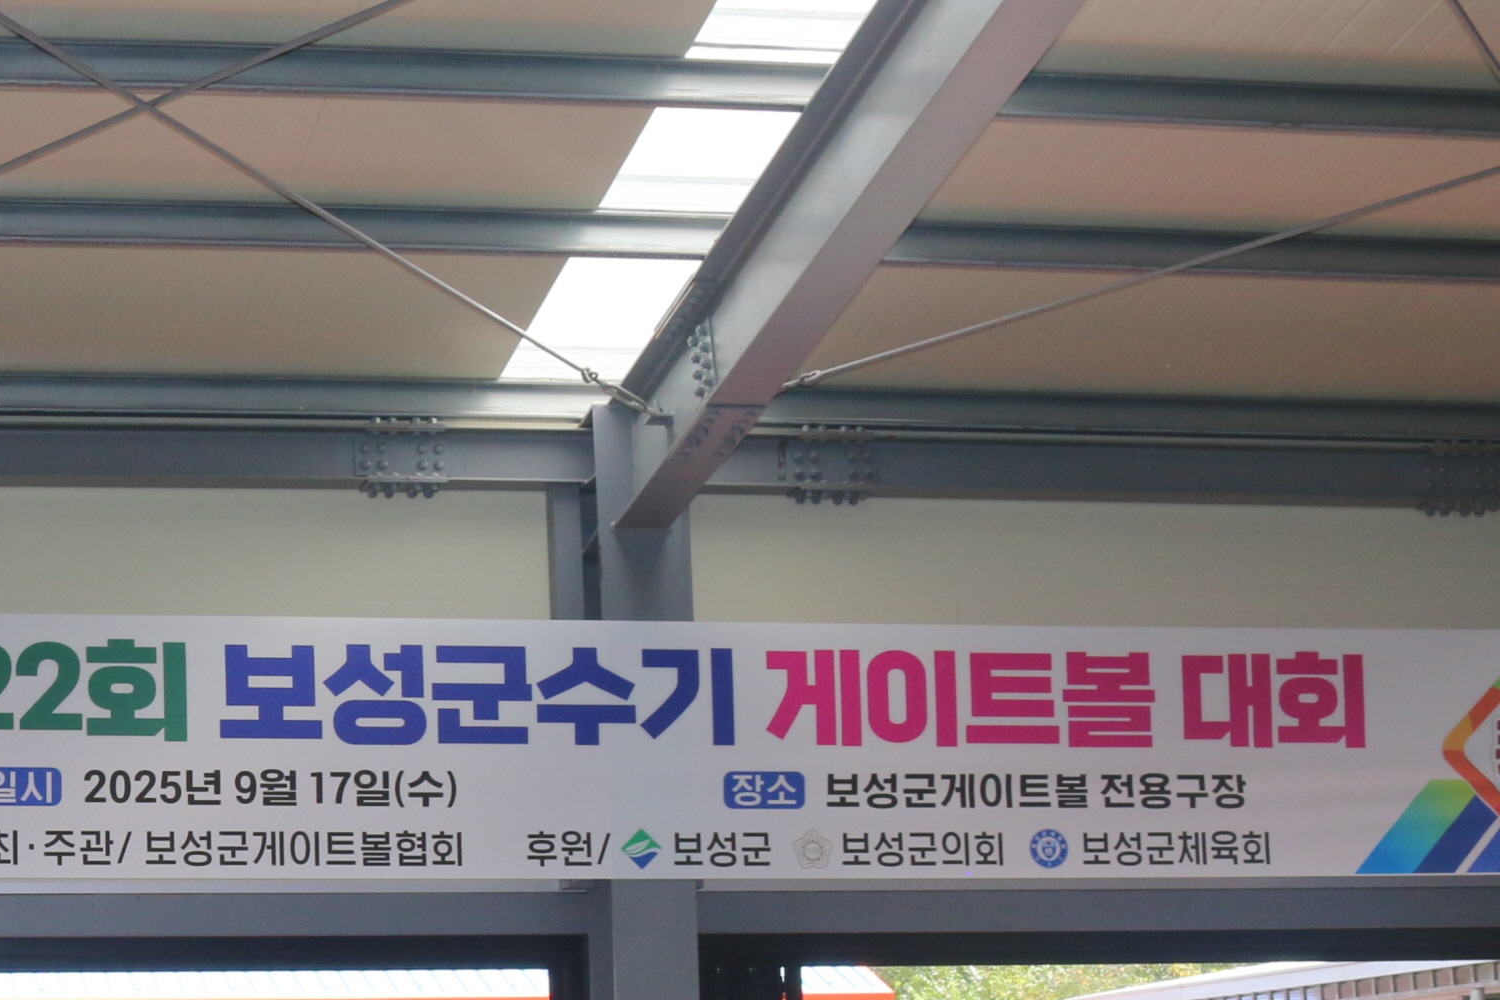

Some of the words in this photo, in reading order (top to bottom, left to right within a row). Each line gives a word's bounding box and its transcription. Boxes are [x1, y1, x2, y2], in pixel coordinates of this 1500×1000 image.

[221, 644, 736, 748] 보성군수기
[766, 649, 1157, 749] 게이트볼
[1182, 651, 1367, 749] 대회
[84, 770, 223, 807] 2025년
[235, 769, 299, 808] 9월
[311, 769, 458, 809] 17일(수)
[731, 774, 797, 806] 장소
[826, 773, 1089, 811] 보성군게이트볼
[1101, 773, 1248, 811] 전용구장
[145, 831, 464, 868] 보성군게이트볼협회
[526, 831, 612, 868] 후원/
[673, 832, 772, 869] 보성군
[842, 831, 1005, 869] 보성군의회
[1083, 831, 1273, 868] 보성군체육회
